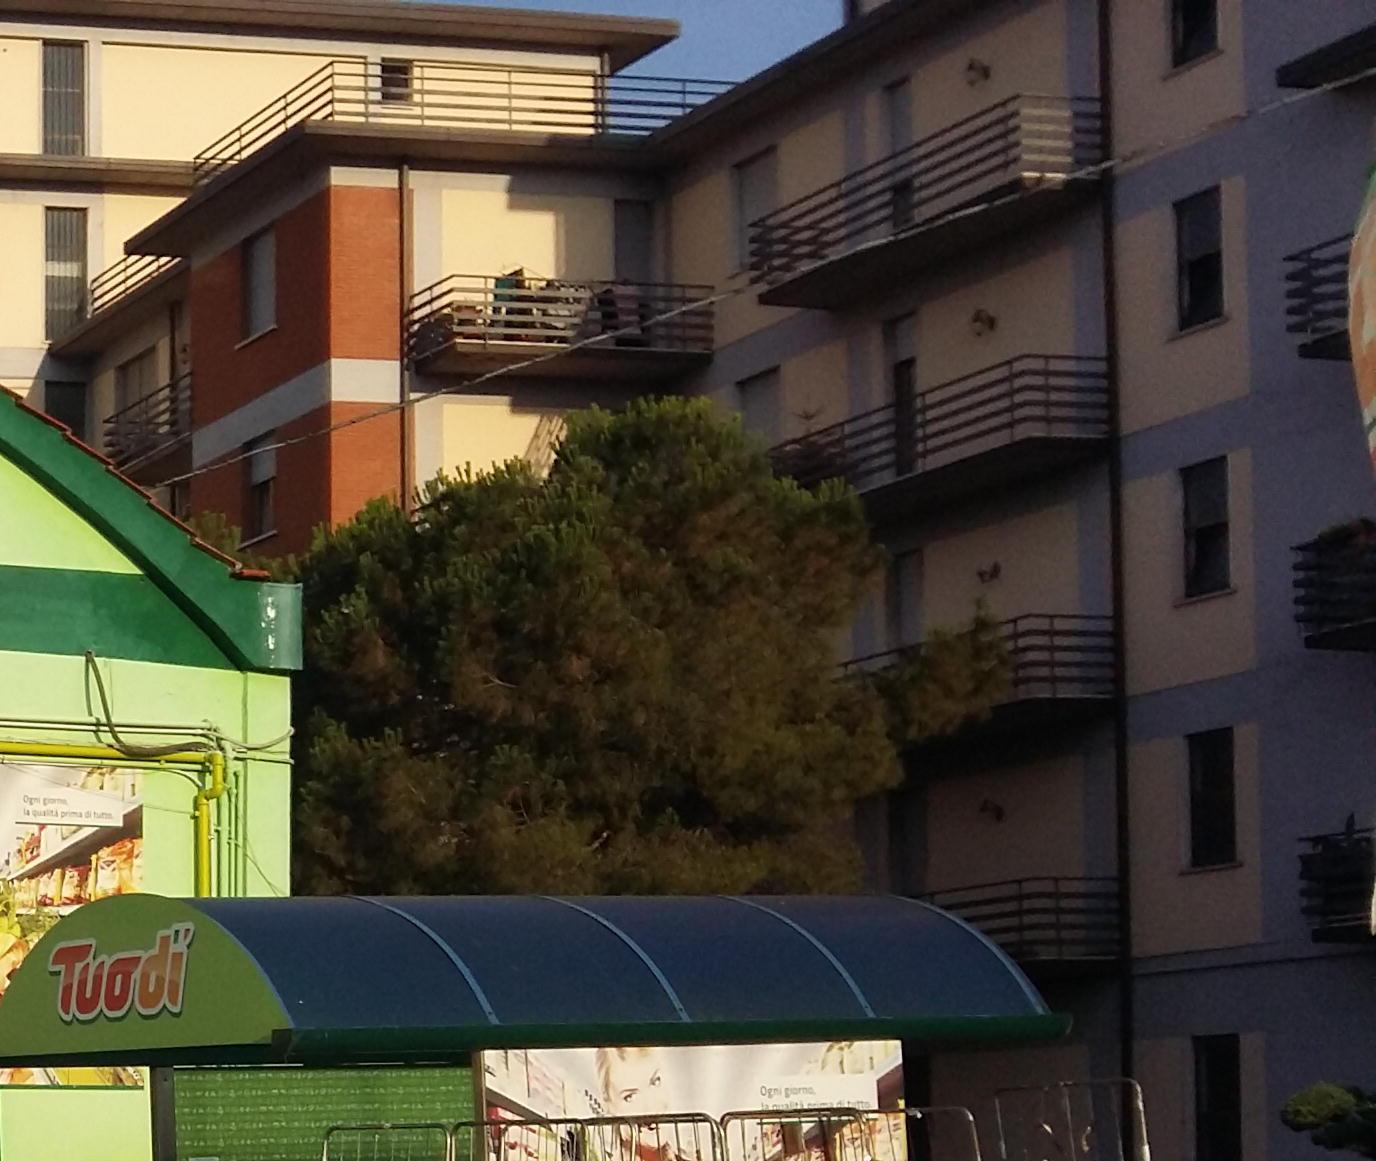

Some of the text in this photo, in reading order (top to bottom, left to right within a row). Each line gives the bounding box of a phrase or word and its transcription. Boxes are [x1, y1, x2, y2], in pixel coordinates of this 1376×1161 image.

[23, 794, 41, 805] Ogni
[23, 808, 31, 816] la
[32, 808, 59, 818] qualità
[61, 810, 83, 818] prima
[85, 810, 92, 818] di
[760, 1085, 816, 1098] Ogni giorno,
